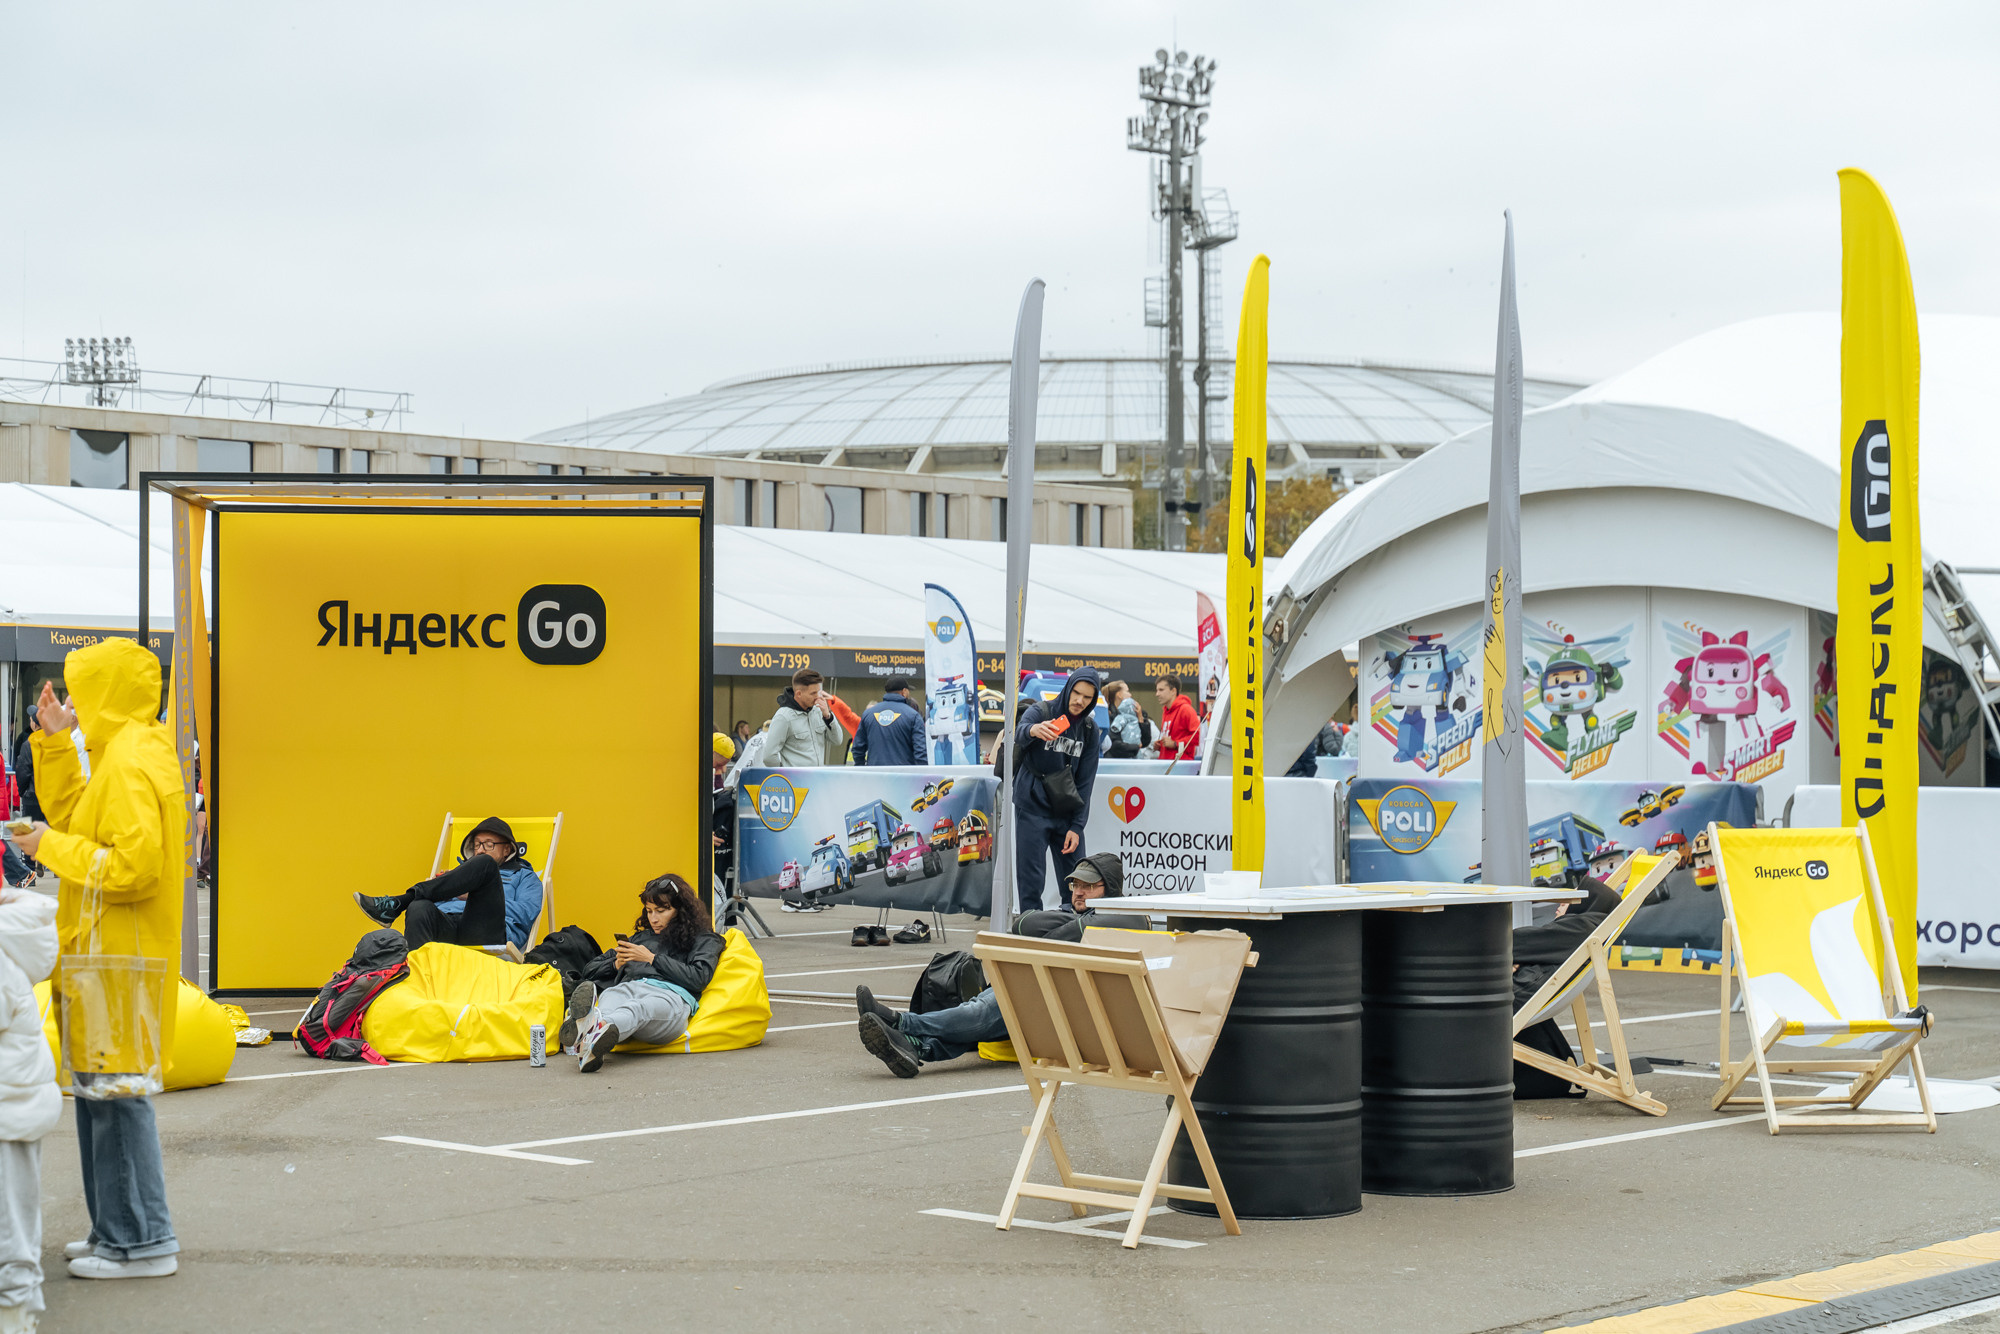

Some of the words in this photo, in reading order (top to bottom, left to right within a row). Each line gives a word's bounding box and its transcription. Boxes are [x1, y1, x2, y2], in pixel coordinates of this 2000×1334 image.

[317, 600, 506, 655] Яндекс
[528, 600, 597, 649] Go
[937, 625, 956, 635] POLI
[50, 631, 98, 648] Камера
[740, 652, 811, 669] 6300-7399
[855, 652, 887, 666] Камера
[889, 655, 925, 666] хранени
[977, 658, 1005, 673] 0-84
[1054, 657, 1084, 670] Камера
[869, 664, 893, 676] Baggage
[895, 666, 917, 676] storage
[1145, 662, 1199, 677] 8500-9499
[1426, 714, 1476, 770] SPEEDY
[1565, 719, 1618, 768] FLYING
[1439, 740, 1471, 775] POLI
[1572, 745, 1611, 777] HELLY
[1722, 733, 1774, 781] SMART
[1735, 754, 1784, 783] AMBER
[761, 794, 793, 814] POLI
[1381, 810, 1432, 832] POLI
[1120, 831, 1233, 851] МОСКОВСКИ
[1416, 836, 1422, 845] 5
[1120, 852, 1207, 871] МАРАФОН
[1754, 866, 1803, 880] Яндекс
[1807, 863, 1827, 877] Go
[1123, 872, 1196, 891] MOSCOW
